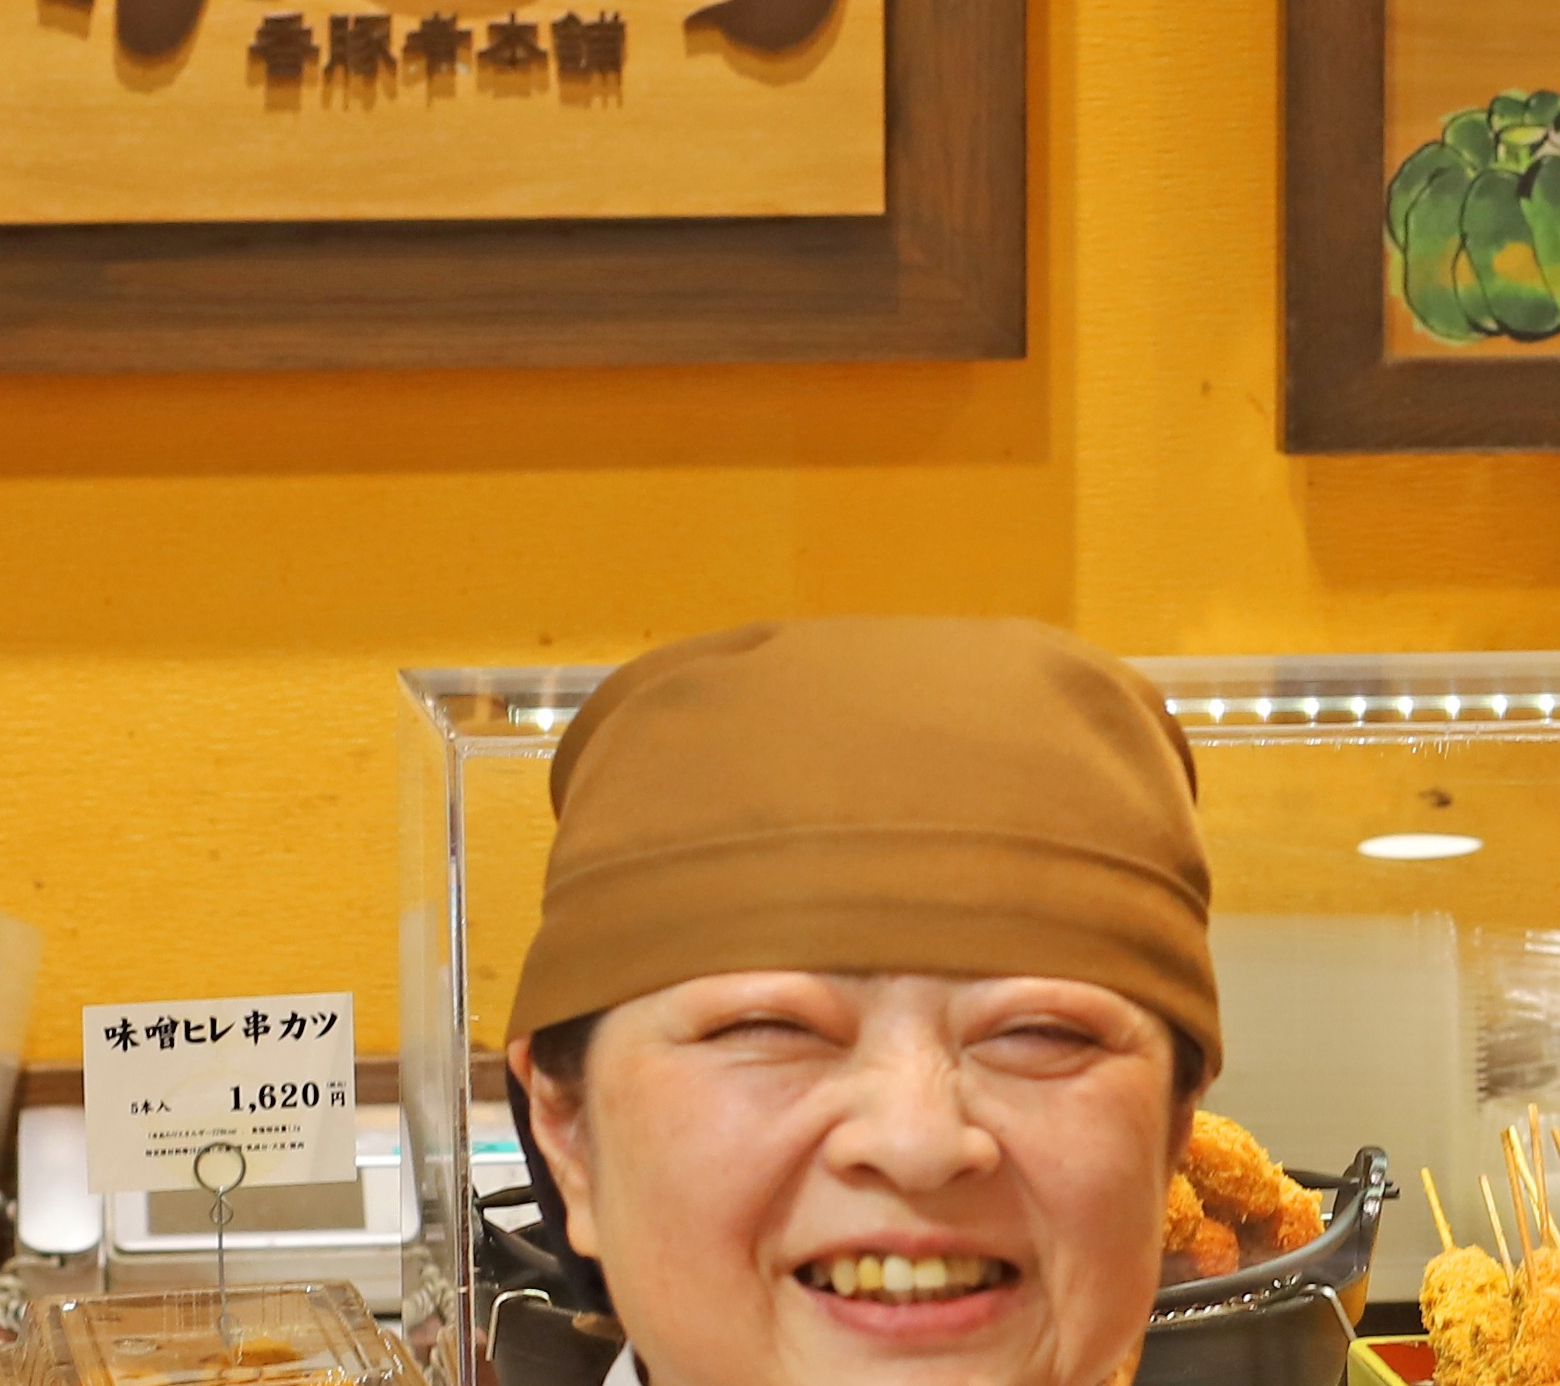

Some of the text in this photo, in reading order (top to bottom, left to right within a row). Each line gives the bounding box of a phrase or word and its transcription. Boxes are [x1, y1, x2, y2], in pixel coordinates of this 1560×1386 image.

[104, 1008, 338, 1052] 味噌ヒレ串カツ
[229, 1082, 320, 1113] 1,620
